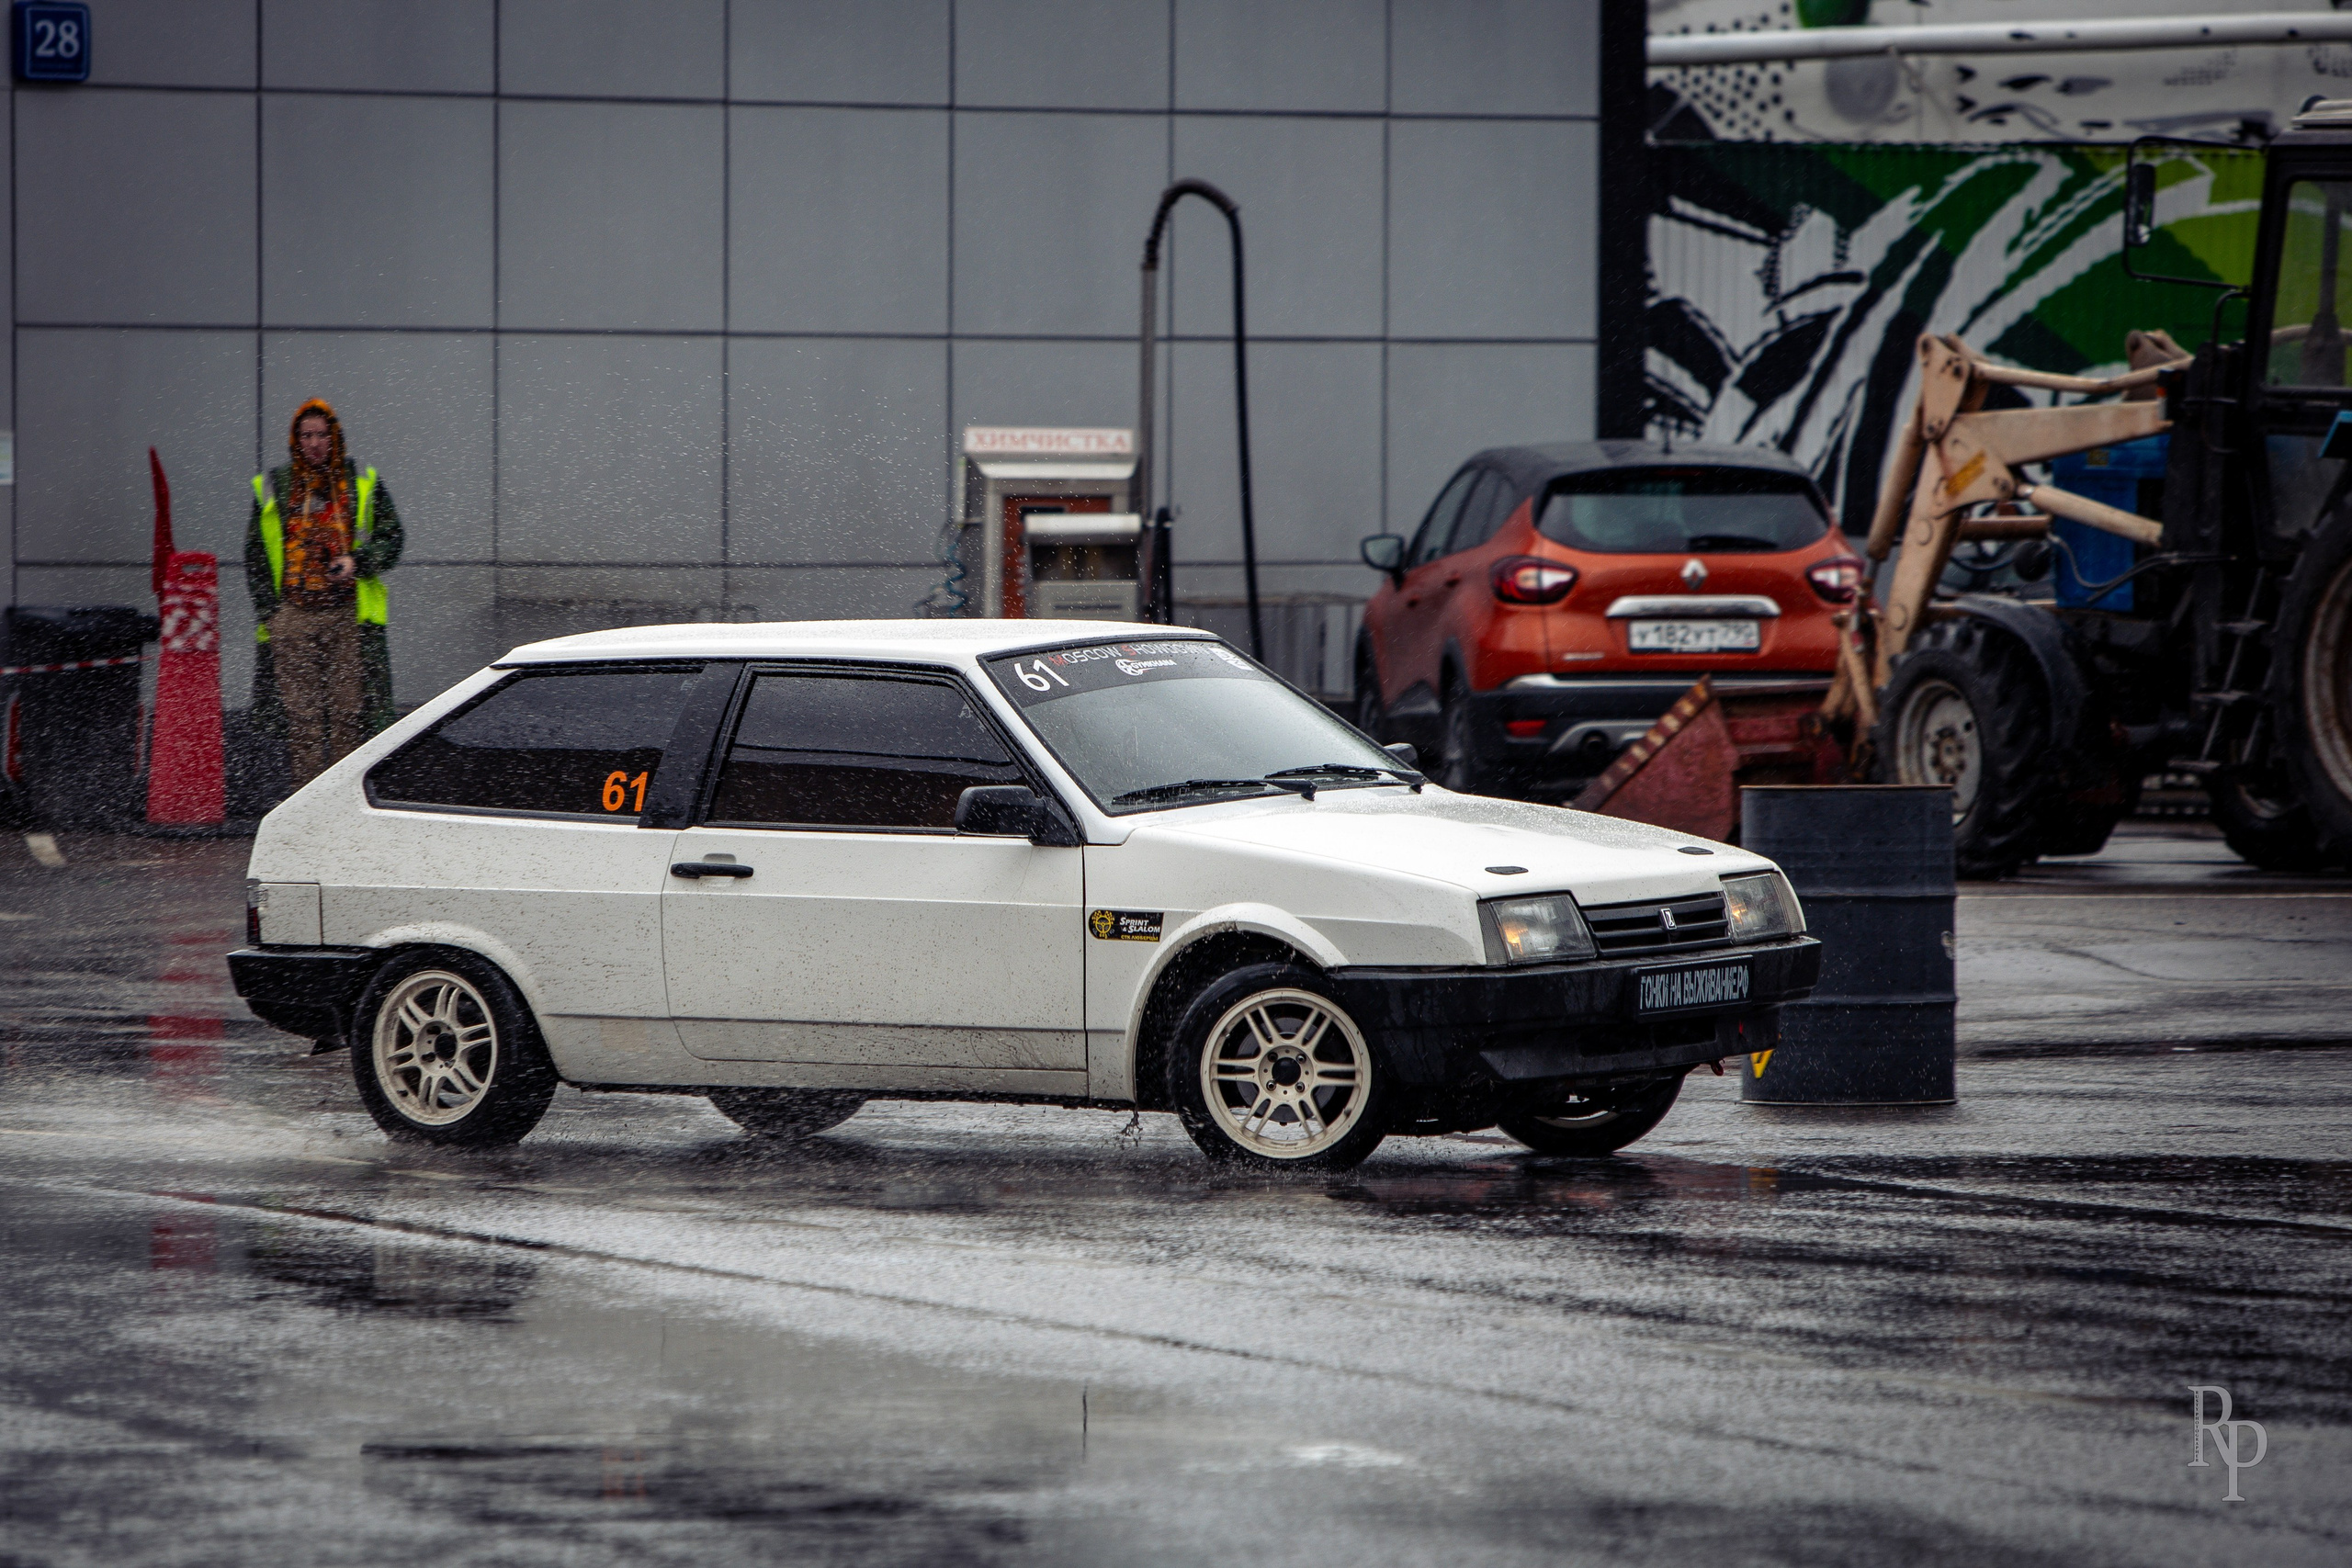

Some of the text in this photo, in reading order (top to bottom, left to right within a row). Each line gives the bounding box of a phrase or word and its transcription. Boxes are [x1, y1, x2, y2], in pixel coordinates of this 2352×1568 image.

[35, 19, 80, 58] 28
[973, 431, 1128, 449] ХИМЧИСТКА
[1047, 646, 1123, 667] MOSCOW
[1130, 659, 1178, 670] GYMKHANA
[1014, 659, 1069, 692] 61
[602, 770, 649, 812] 61
[1120, 917, 1148, 926] SPRINT
